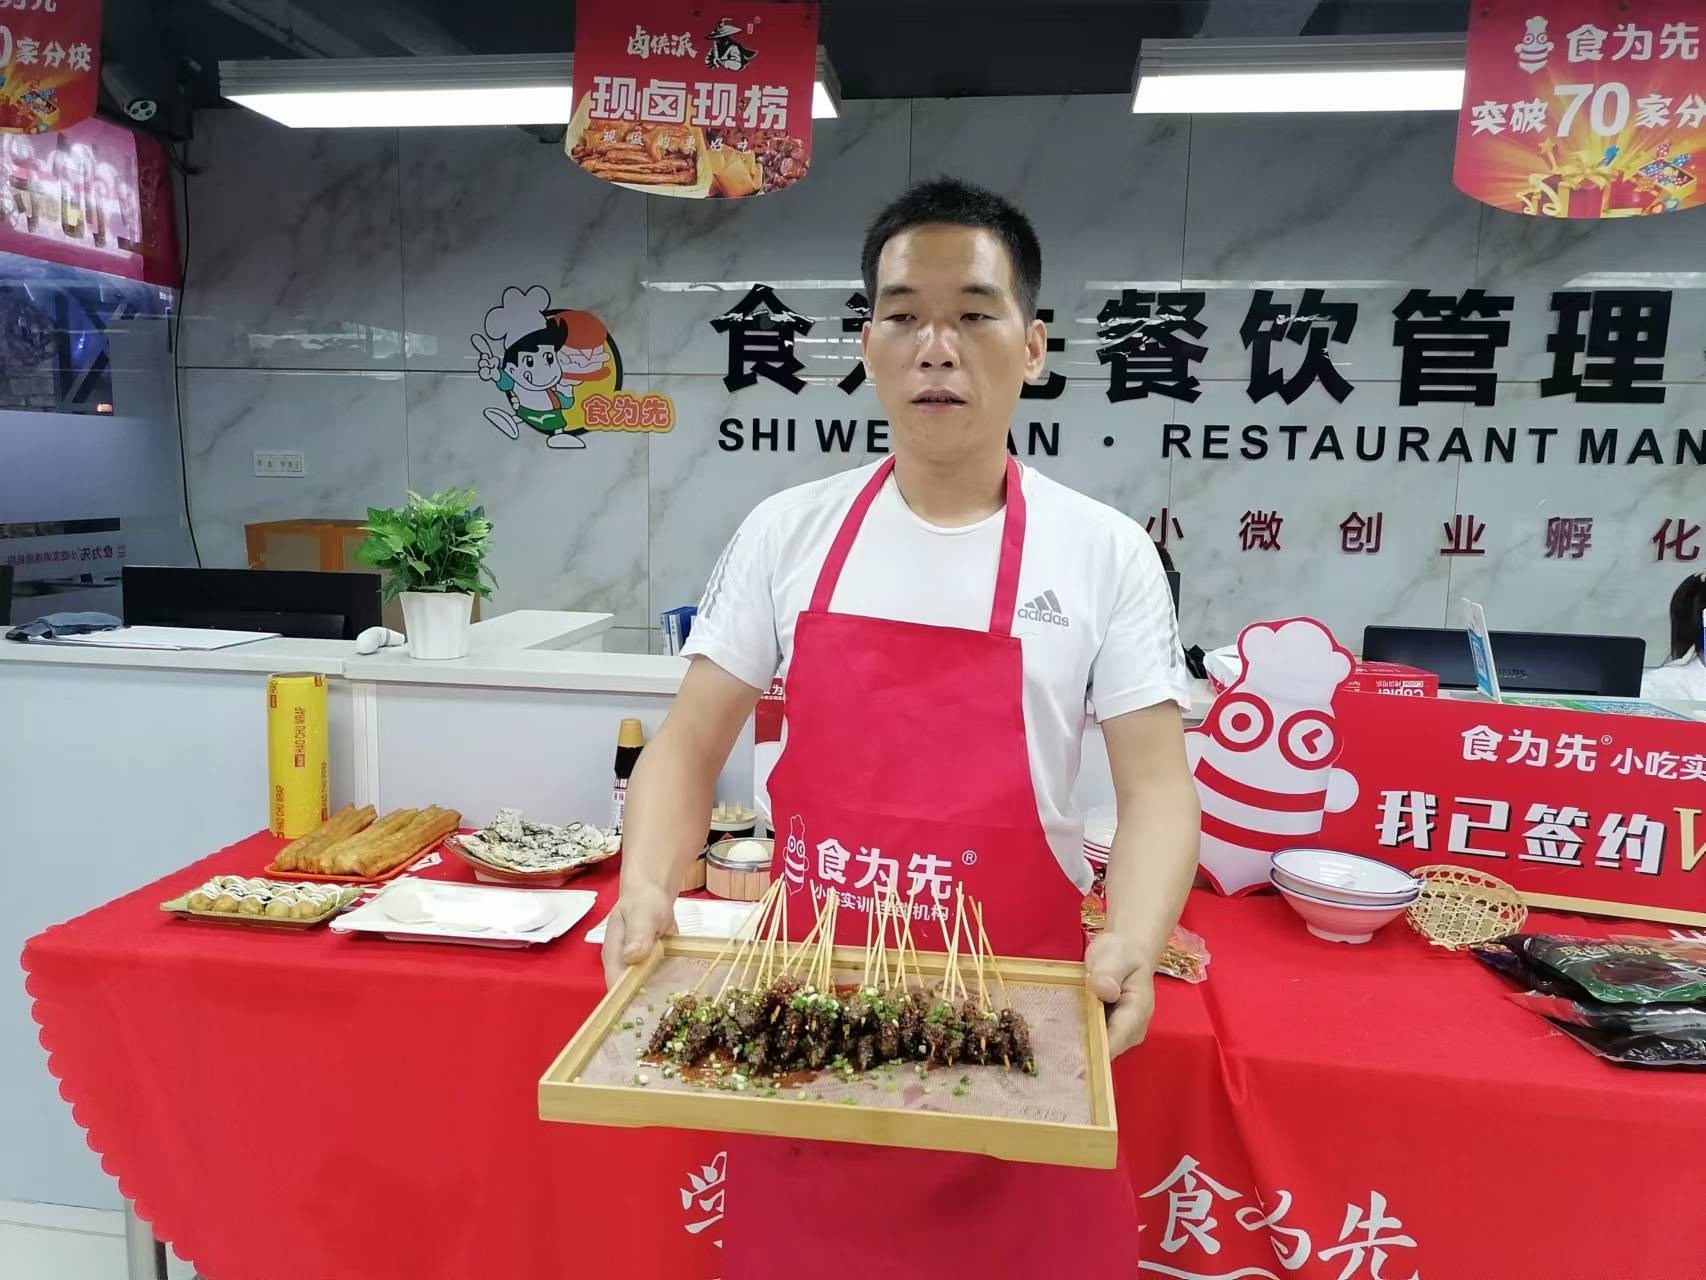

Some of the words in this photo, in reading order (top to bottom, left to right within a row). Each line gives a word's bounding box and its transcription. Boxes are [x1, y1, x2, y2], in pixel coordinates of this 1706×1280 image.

[1566, 22, 1699, 63] 食为先
[590, 76, 789, 130] 现卤现捞
[709, 283, 1674, 406] 食餐饮管理
[583, 394, 670, 428] 食为先
[718, 418, 796, 451] SHI
[814, 419, 890, 453] WE
[1161, 423, 1557, 463] RESTAURANT
[1145, 507, 1701, 562] 小微创业孵化
[1017, 608, 1070, 627] adidas
[1461, 725, 1597, 772] 食为先
[816, 838, 953, 900] 食为先
